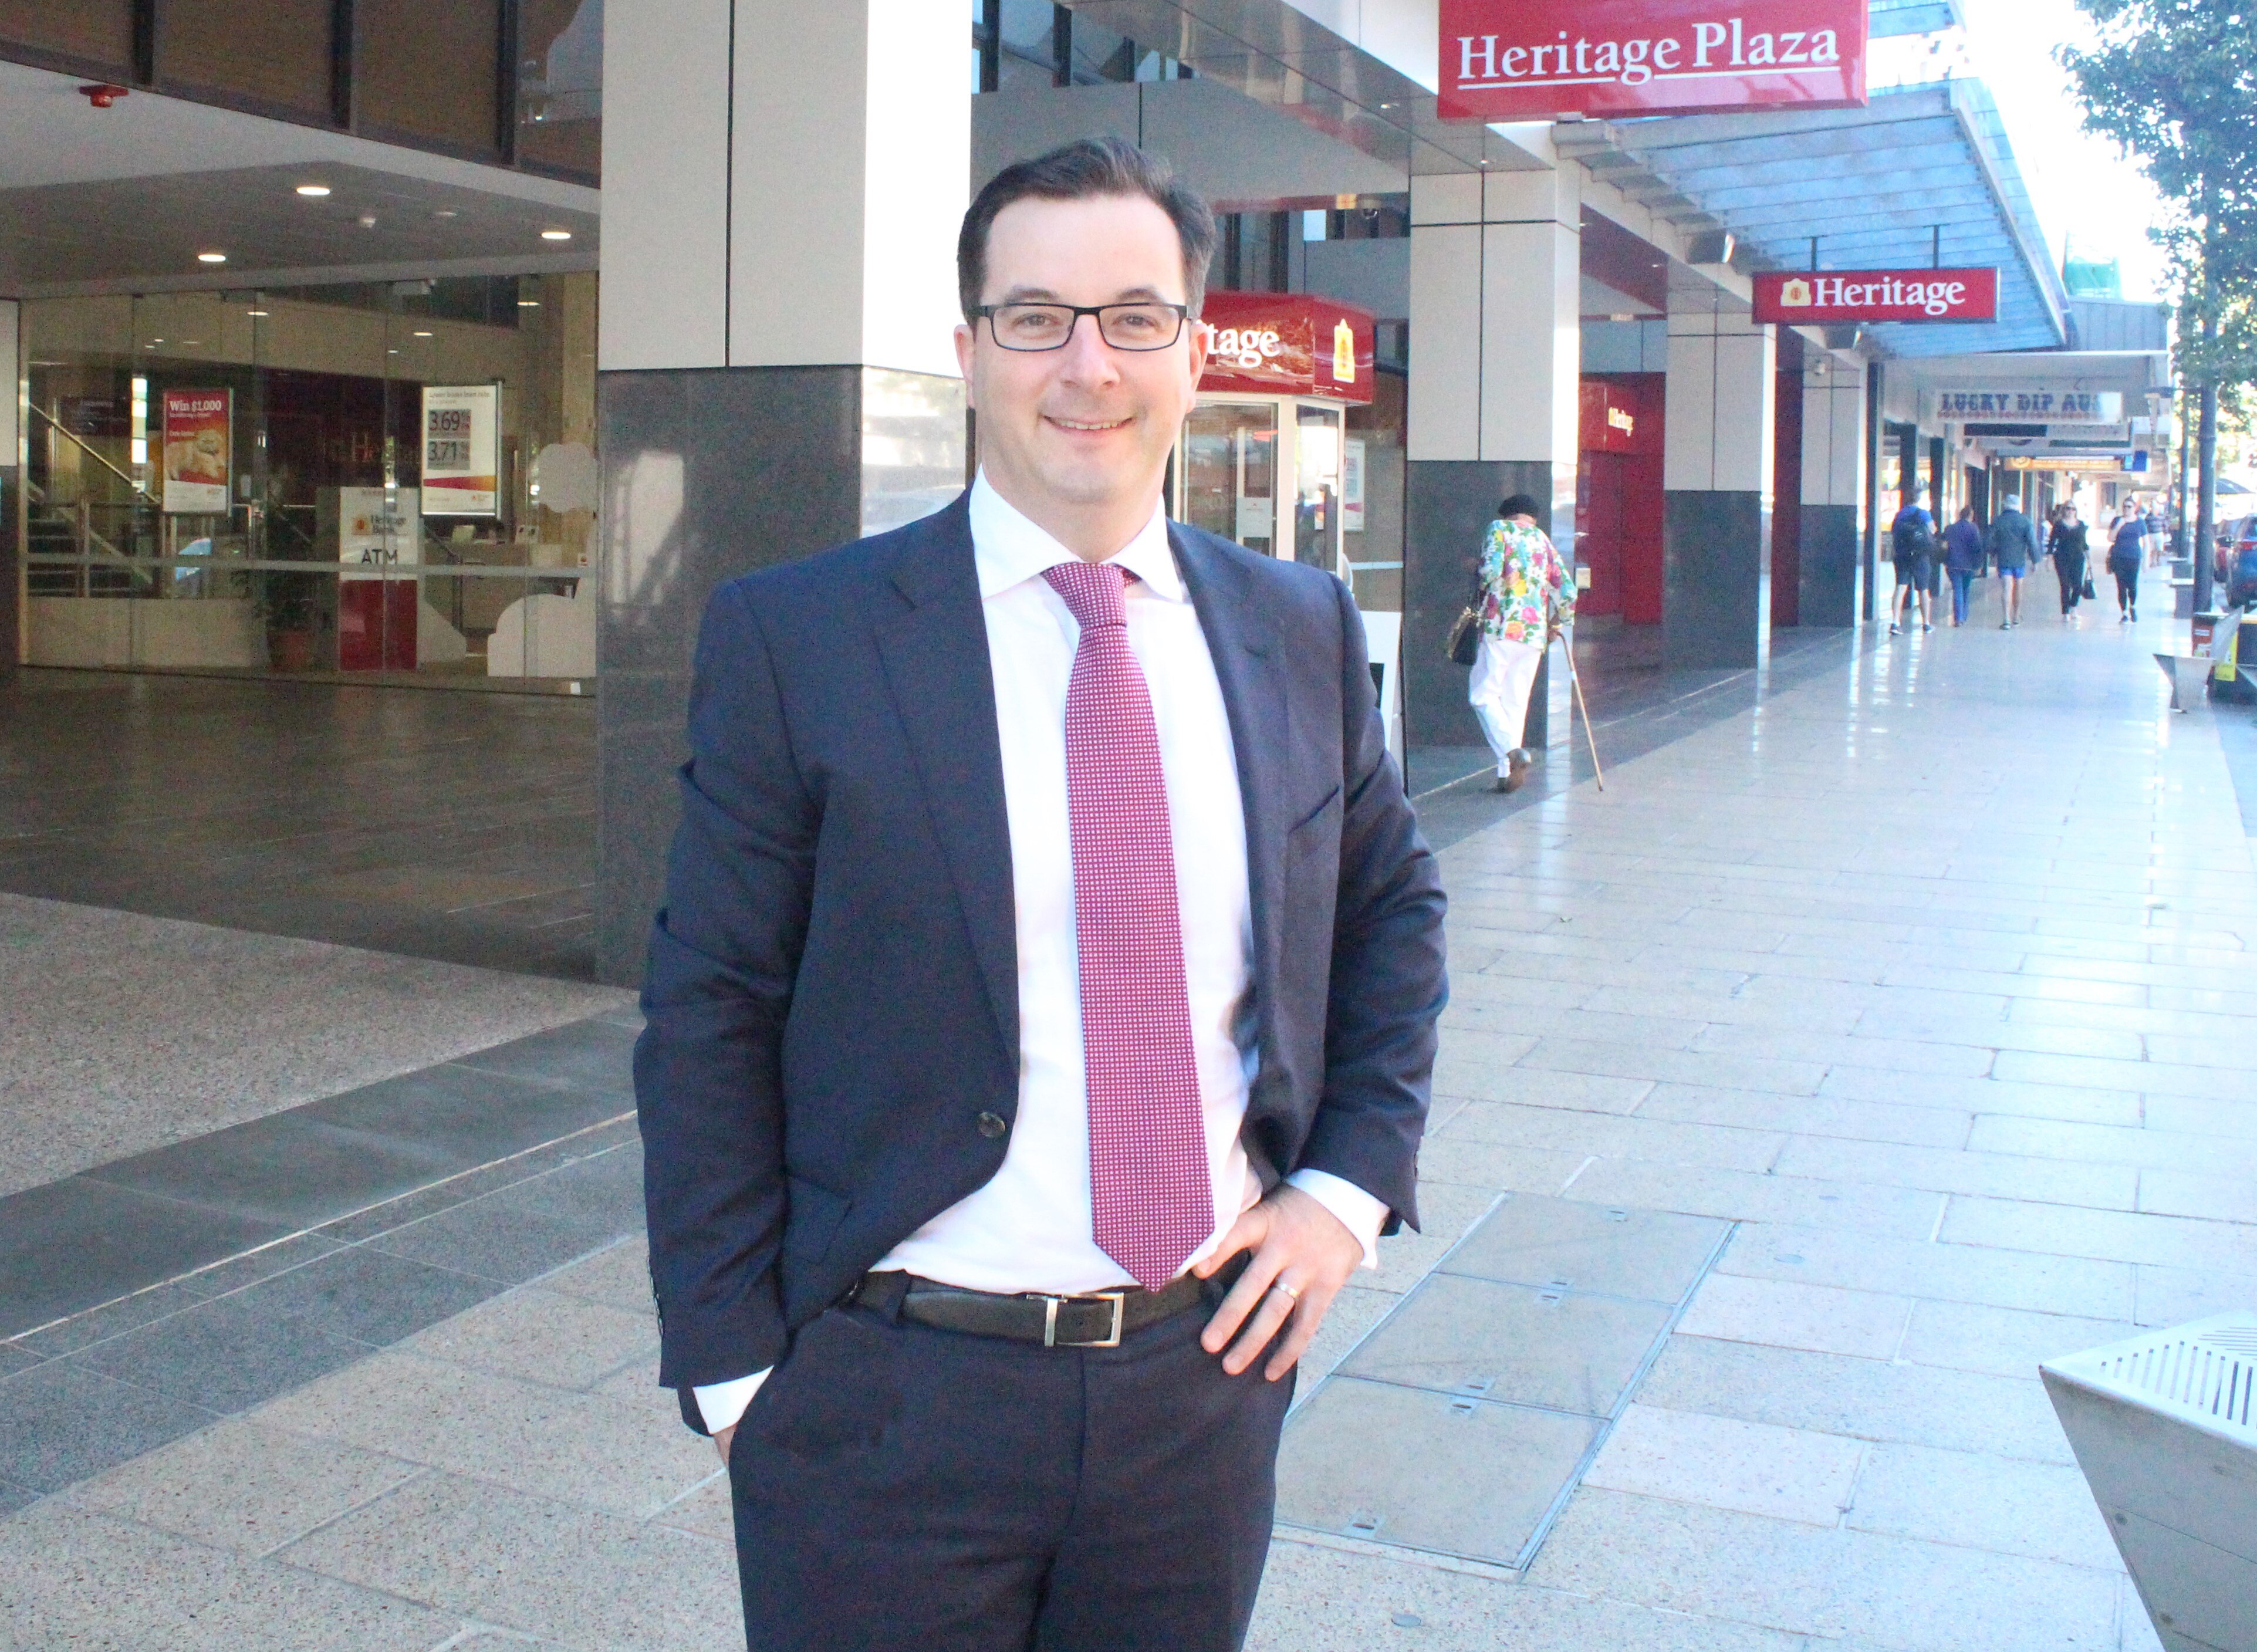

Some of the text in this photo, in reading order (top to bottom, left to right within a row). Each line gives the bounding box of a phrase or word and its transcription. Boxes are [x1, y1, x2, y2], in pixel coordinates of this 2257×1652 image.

[1457, 18, 1840, 86] Heritage Plaza
[1814, 276, 1965, 316] Heritage
[1207, 323, 1280, 369] tage
[170, 400, 190, 411] Win
[1942, 393, 2009, 411] LUCKY
[2018, 393, 2053, 411] DIP
[361, 549, 397, 564] ATM
